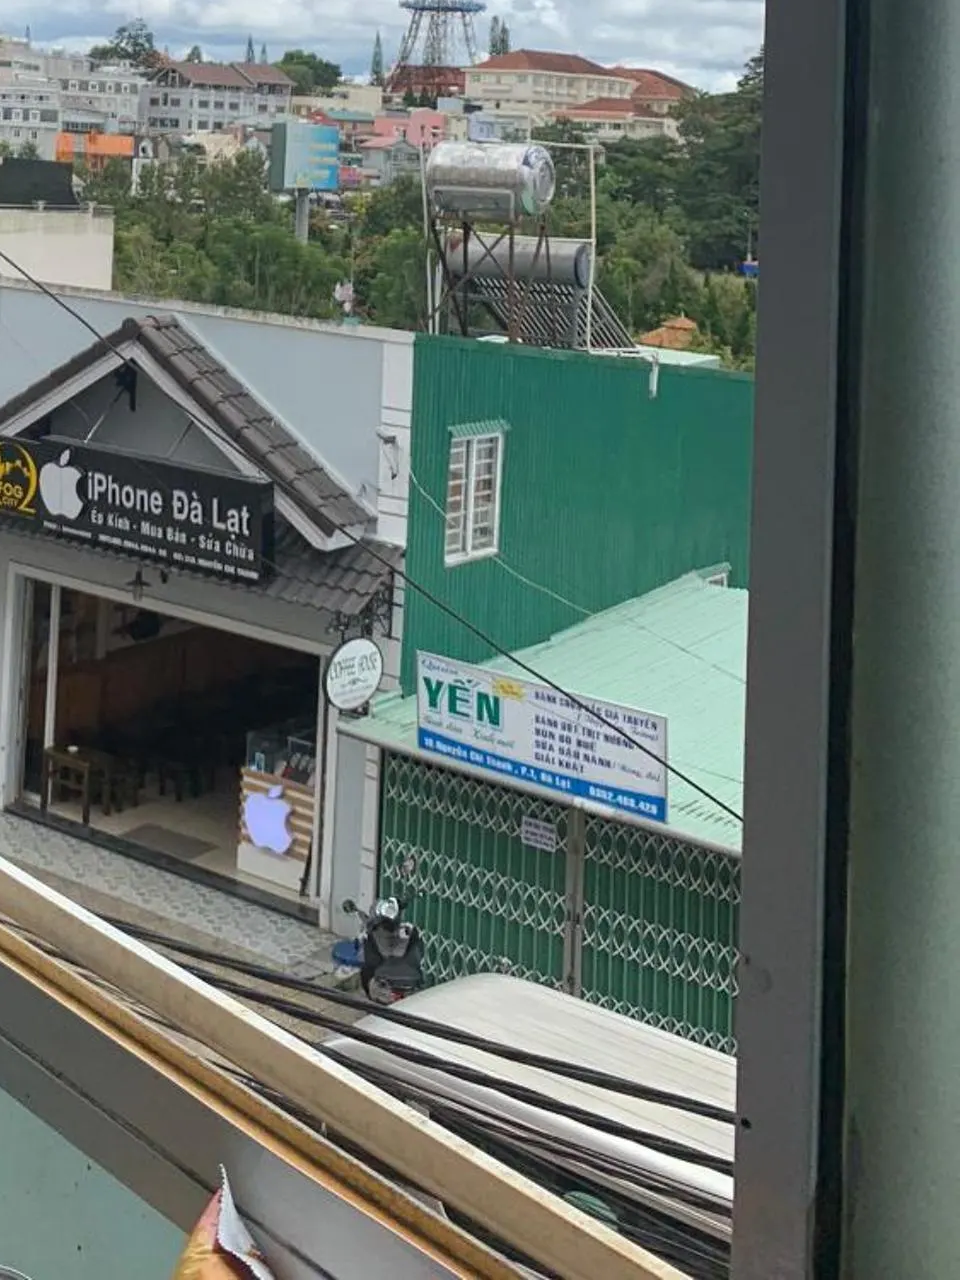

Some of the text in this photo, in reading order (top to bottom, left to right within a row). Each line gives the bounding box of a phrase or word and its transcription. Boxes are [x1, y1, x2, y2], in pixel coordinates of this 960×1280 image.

[2, 497, 18, 507] CITY
[88, 471, 250, 539] iPhone Đà Lạt
[140, 521, 163, 539] Mua
[422, 677, 500, 727] YẾN
